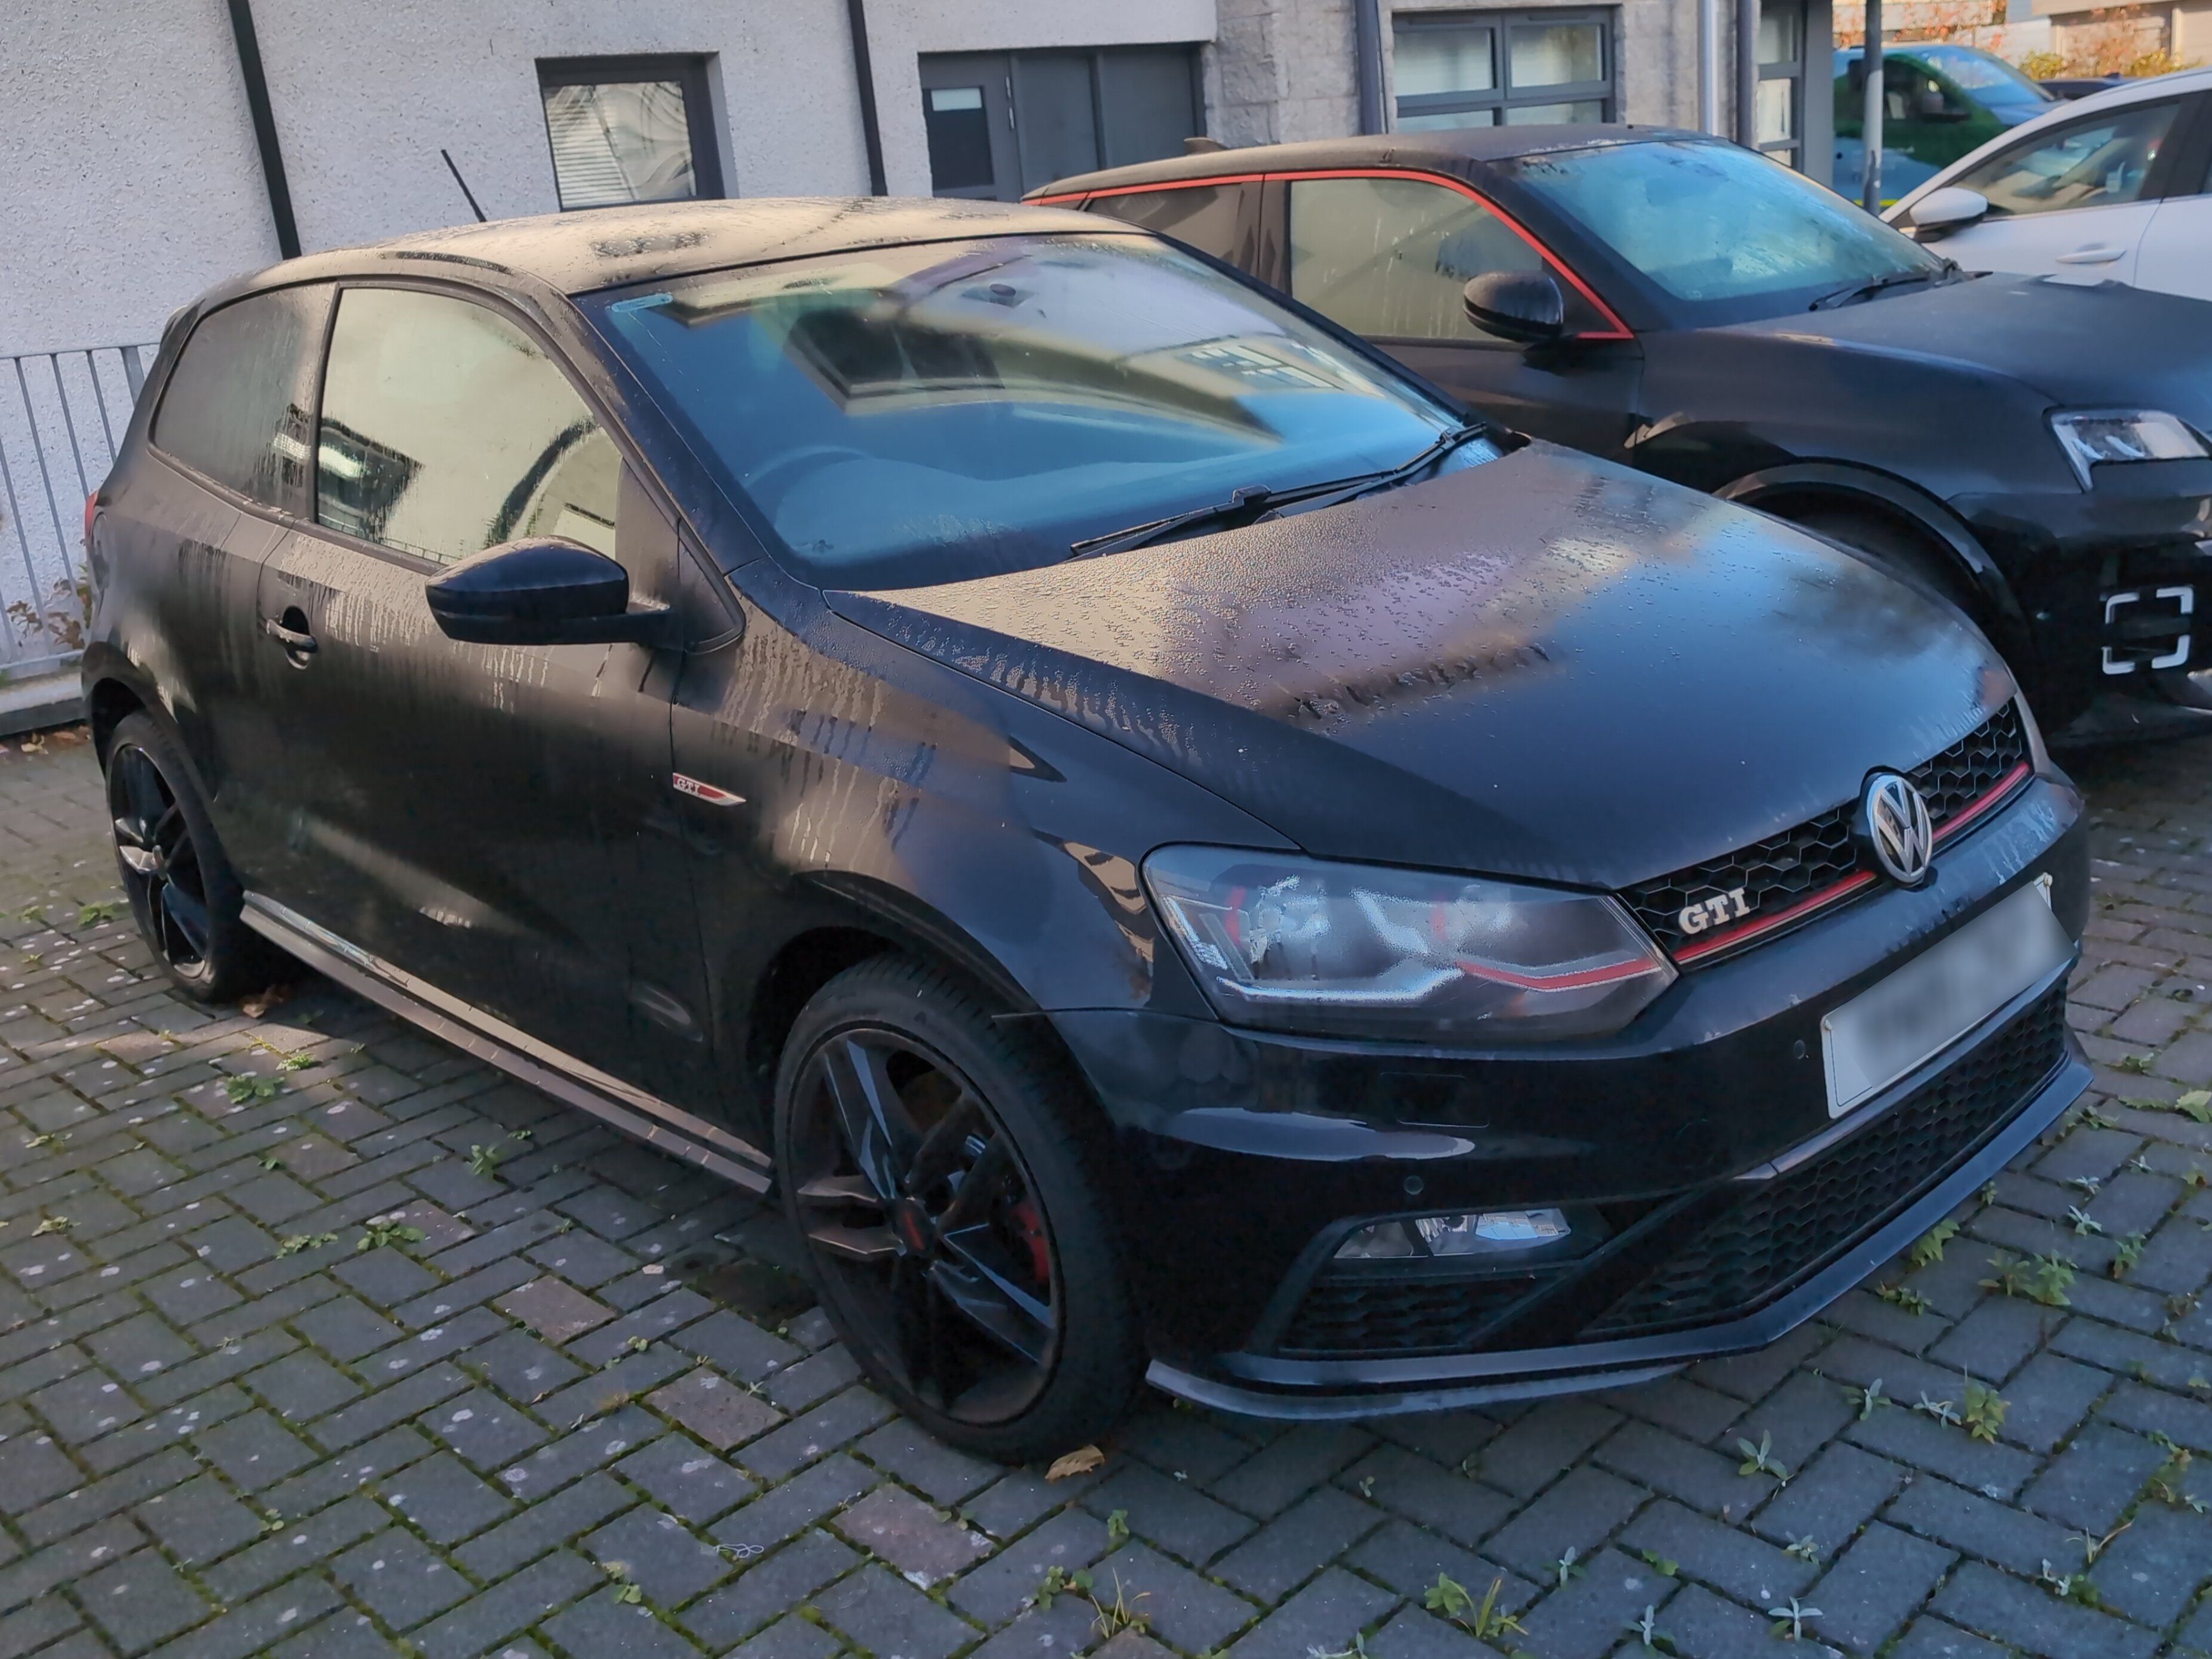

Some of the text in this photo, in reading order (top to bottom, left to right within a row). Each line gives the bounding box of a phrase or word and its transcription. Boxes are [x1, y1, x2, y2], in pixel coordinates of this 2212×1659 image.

[676, 778, 700, 796] GTI
[1869, 776, 1932, 881] VW
[1678, 887, 1751, 934] GTI
